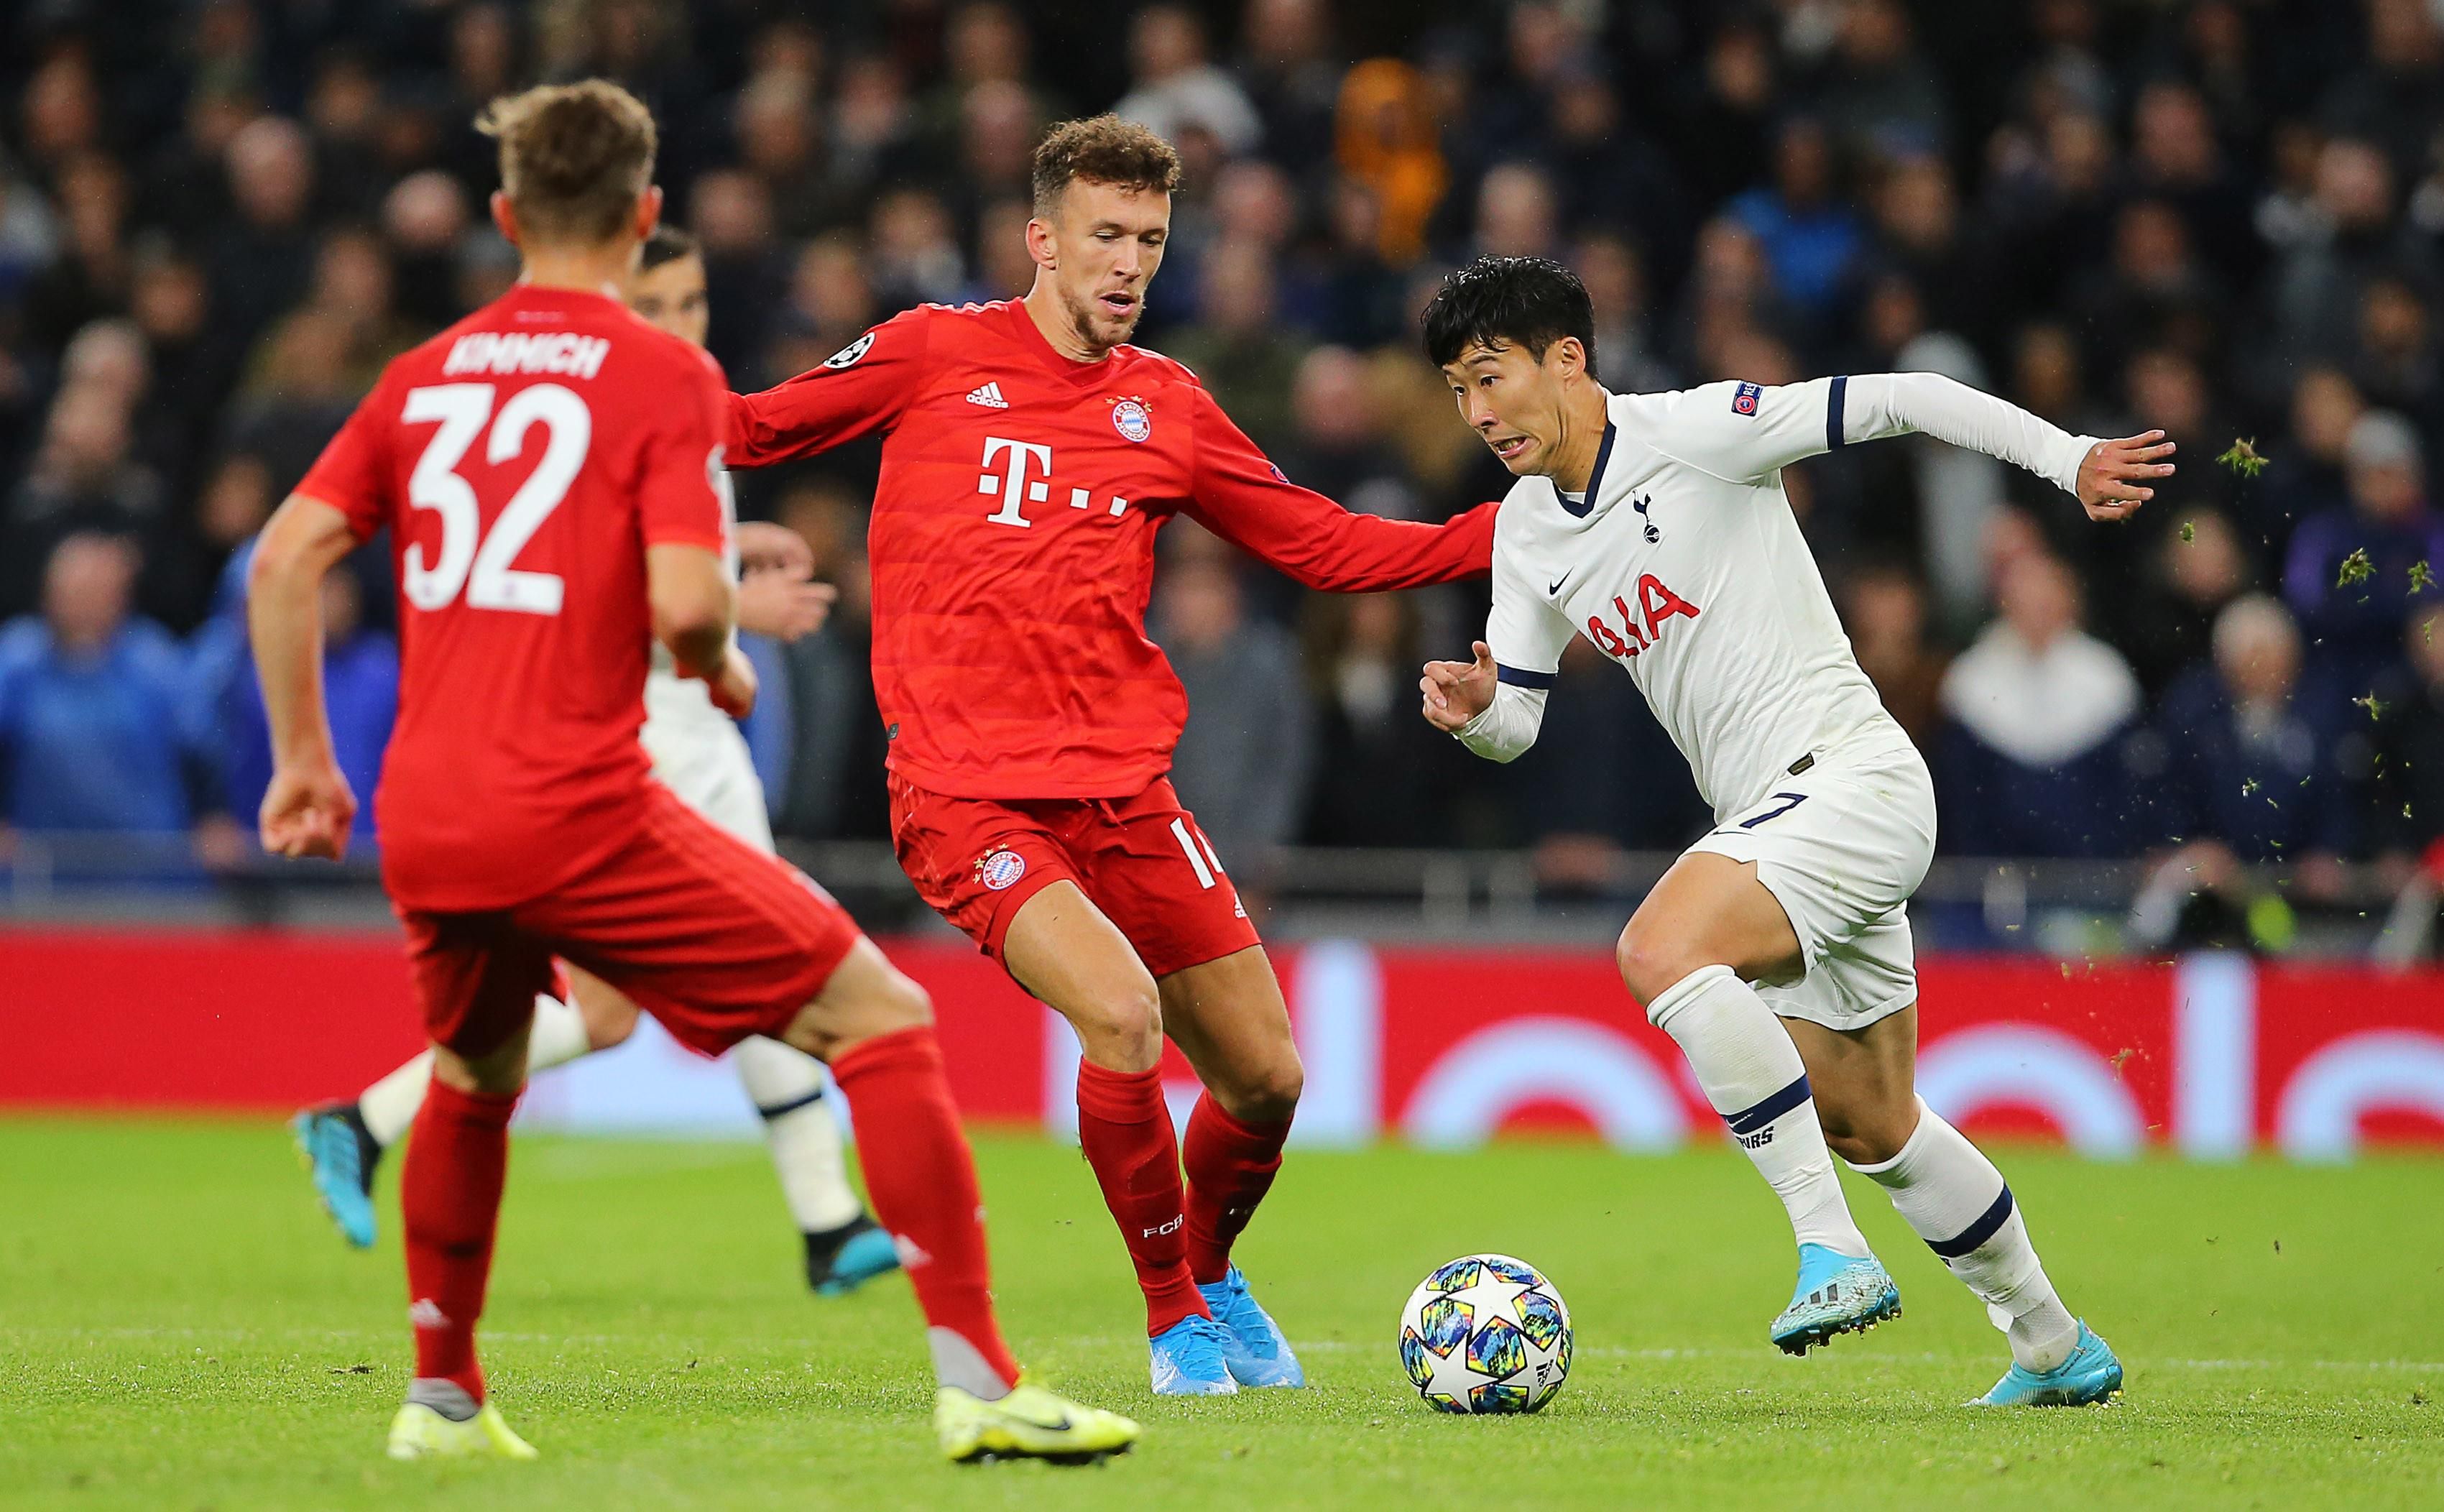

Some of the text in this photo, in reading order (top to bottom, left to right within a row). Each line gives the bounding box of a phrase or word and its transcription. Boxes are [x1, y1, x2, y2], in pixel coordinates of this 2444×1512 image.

[442, 332, 611, 379] KIMMICH
[966, 394, 1009, 408] adidas
[400, 382, 592, 616] 32
[1588, 573, 1700, 658] AIA
[1738, 793, 1809, 829] 7
[1143, 1213, 1184, 1238] FCB
